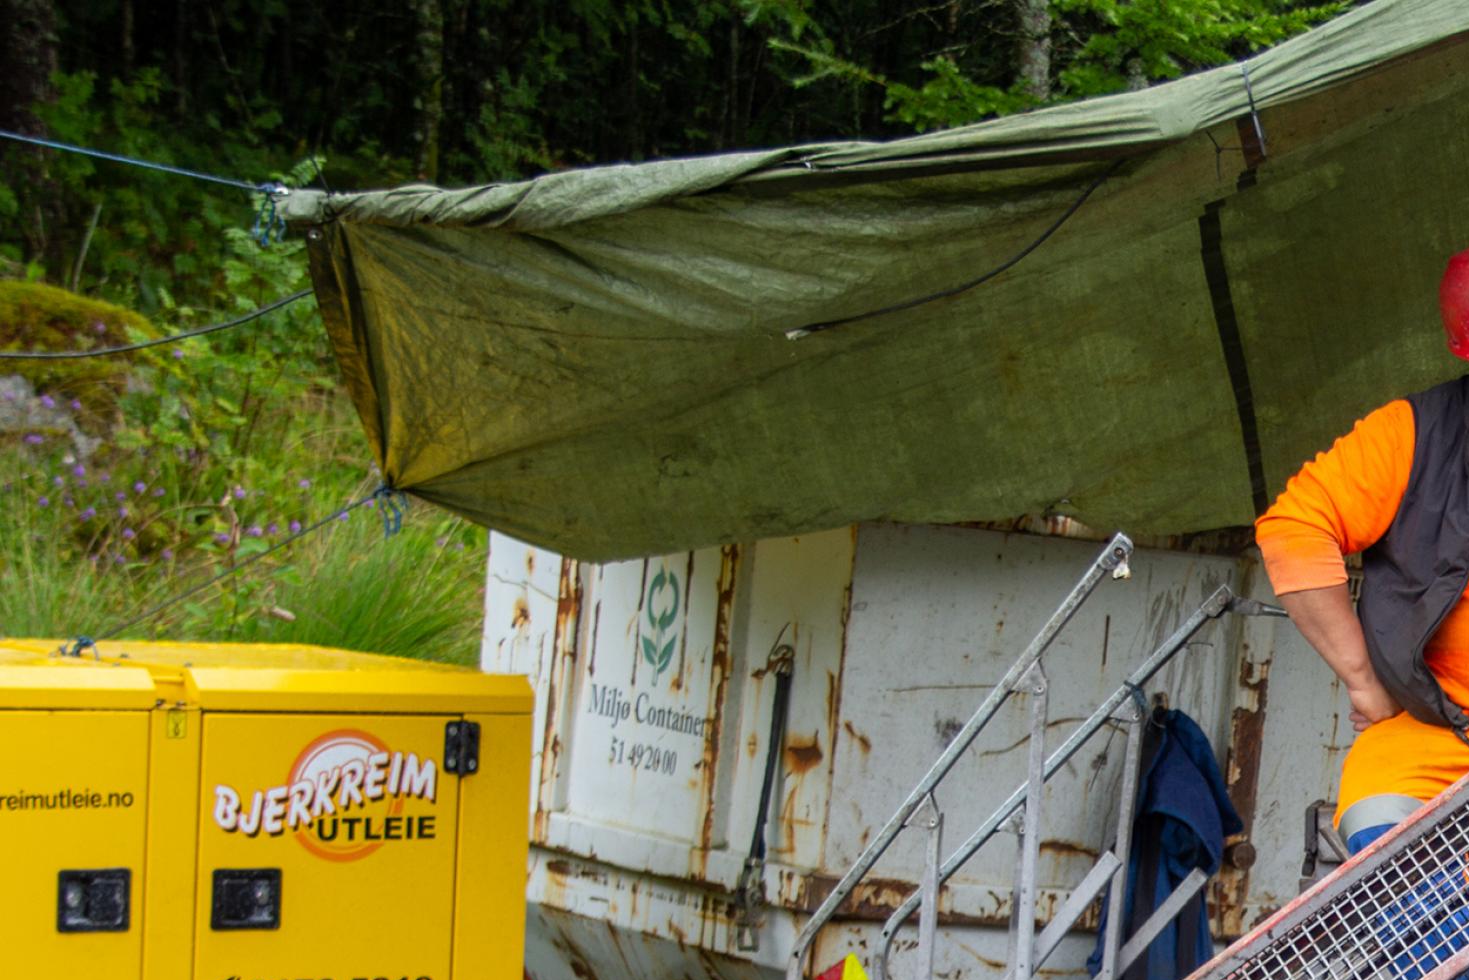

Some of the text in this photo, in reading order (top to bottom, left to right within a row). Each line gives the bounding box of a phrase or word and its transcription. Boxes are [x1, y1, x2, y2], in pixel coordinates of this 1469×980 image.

[588, 684, 706, 738] Miljø Container
[214, 751, 437, 838] BJERKREIM
[317, 817, 437, 842] UTLEIE
